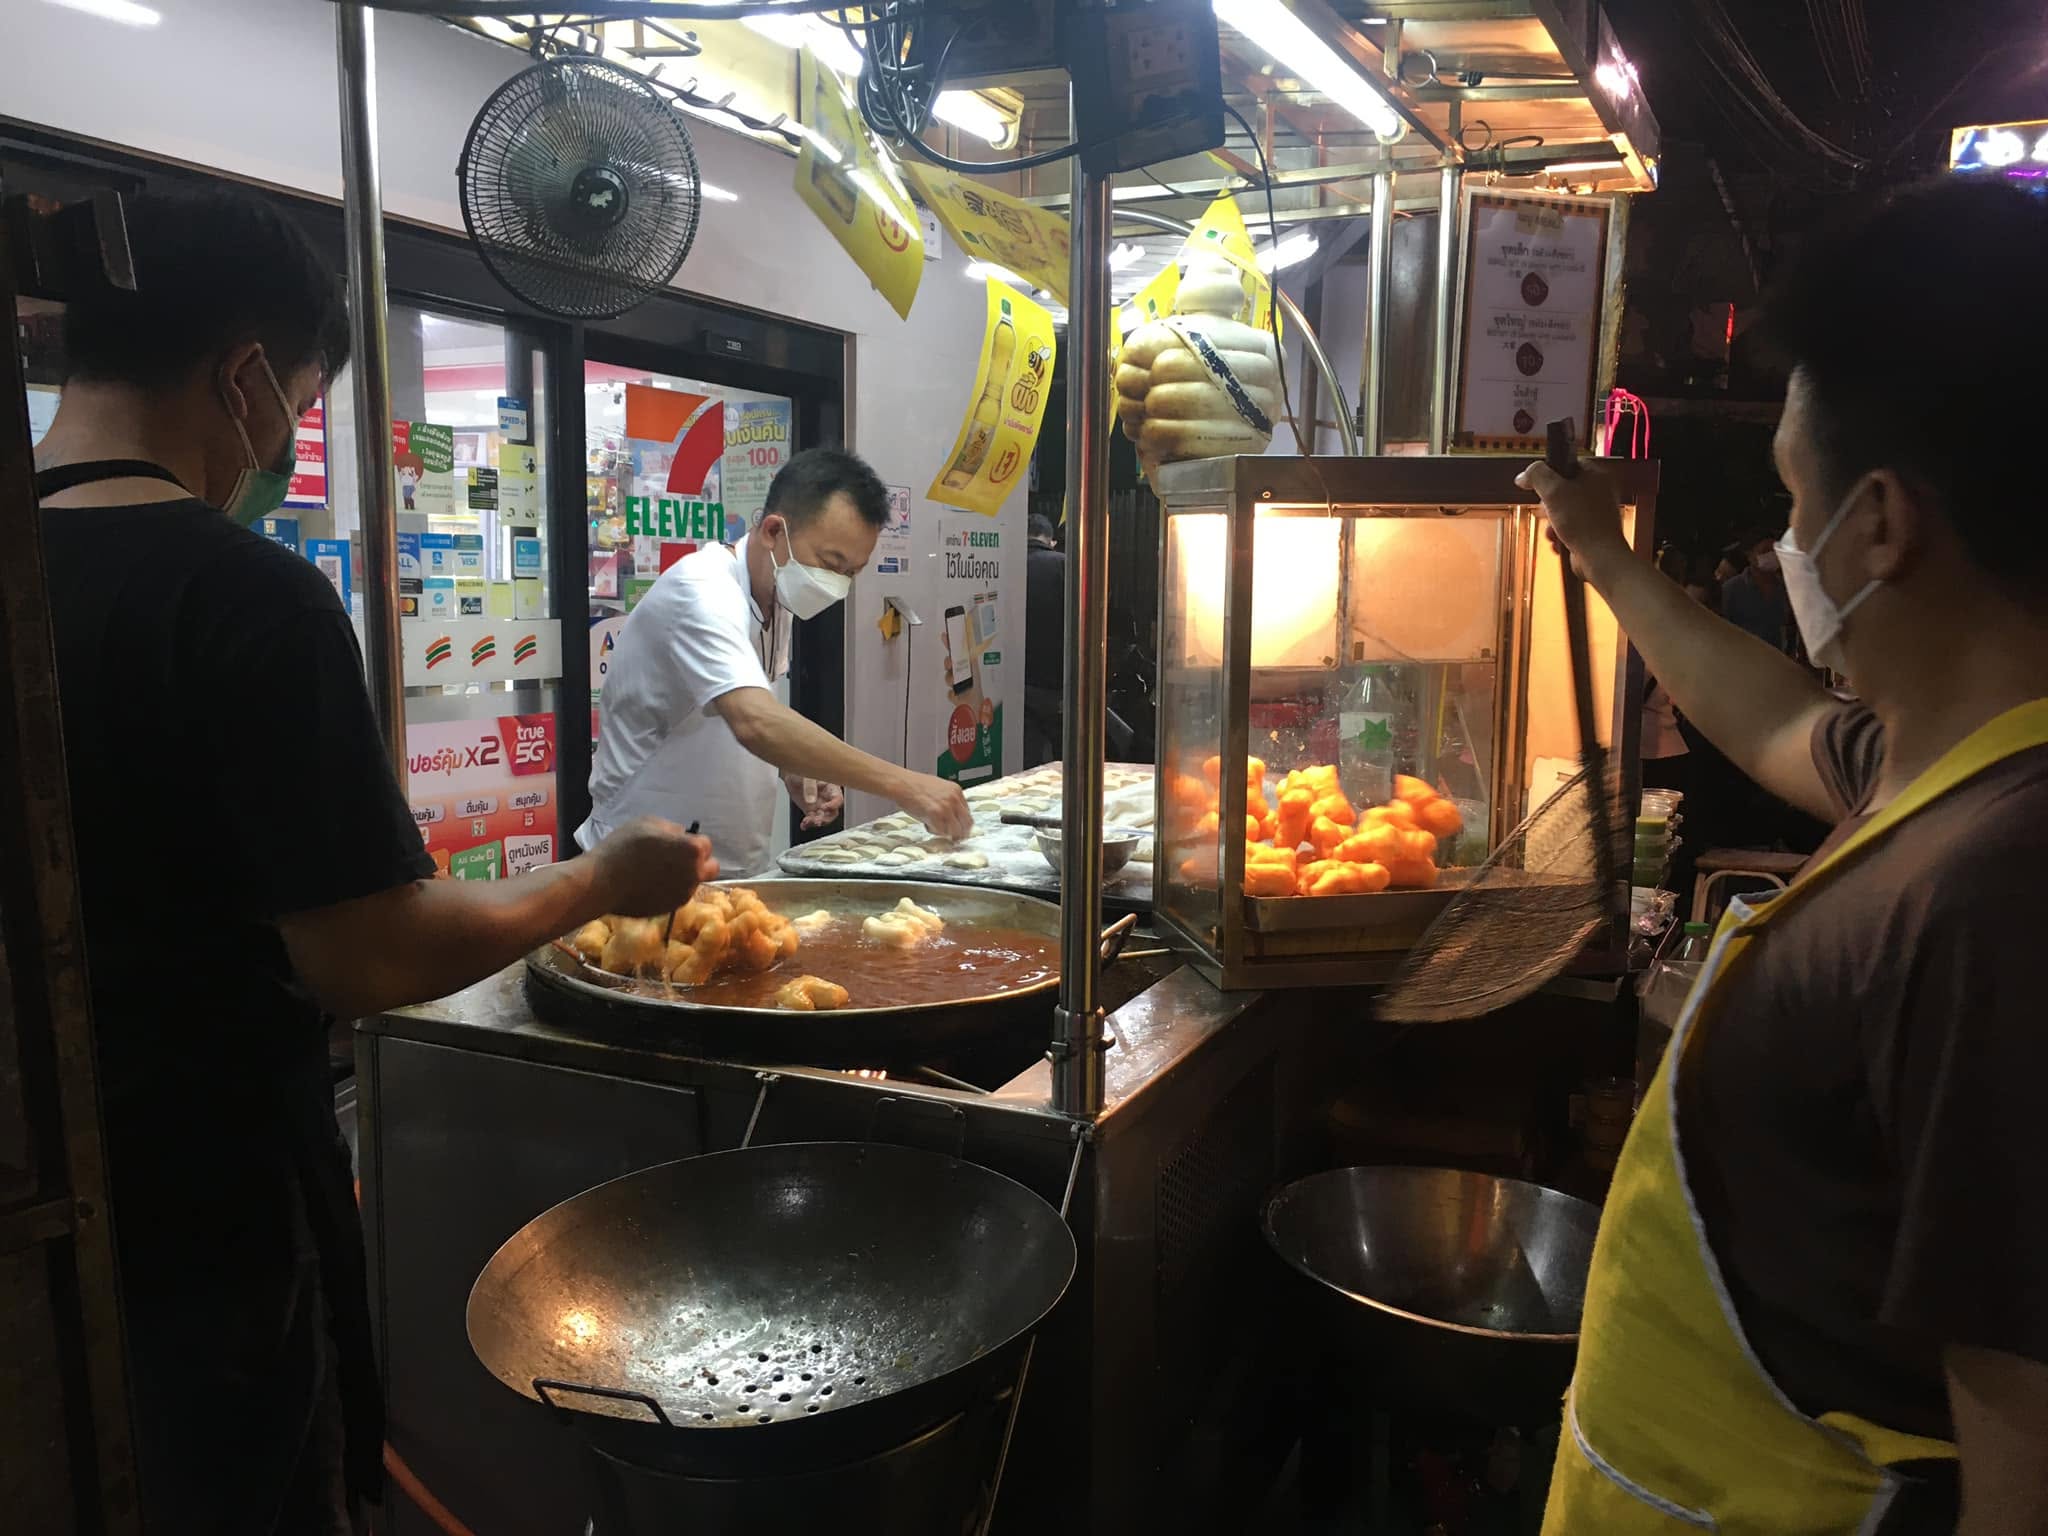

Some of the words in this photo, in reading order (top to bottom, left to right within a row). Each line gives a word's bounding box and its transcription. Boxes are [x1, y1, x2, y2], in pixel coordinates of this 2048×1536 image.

[747, 447, 779, 466] 100
[516, 725, 545, 740] true
[407, 747, 463, 777] ปอร์คุ้ม
[515, 740, 546, 765] 5G
[508, 840, 549, 864] ดูหนังฟรี
